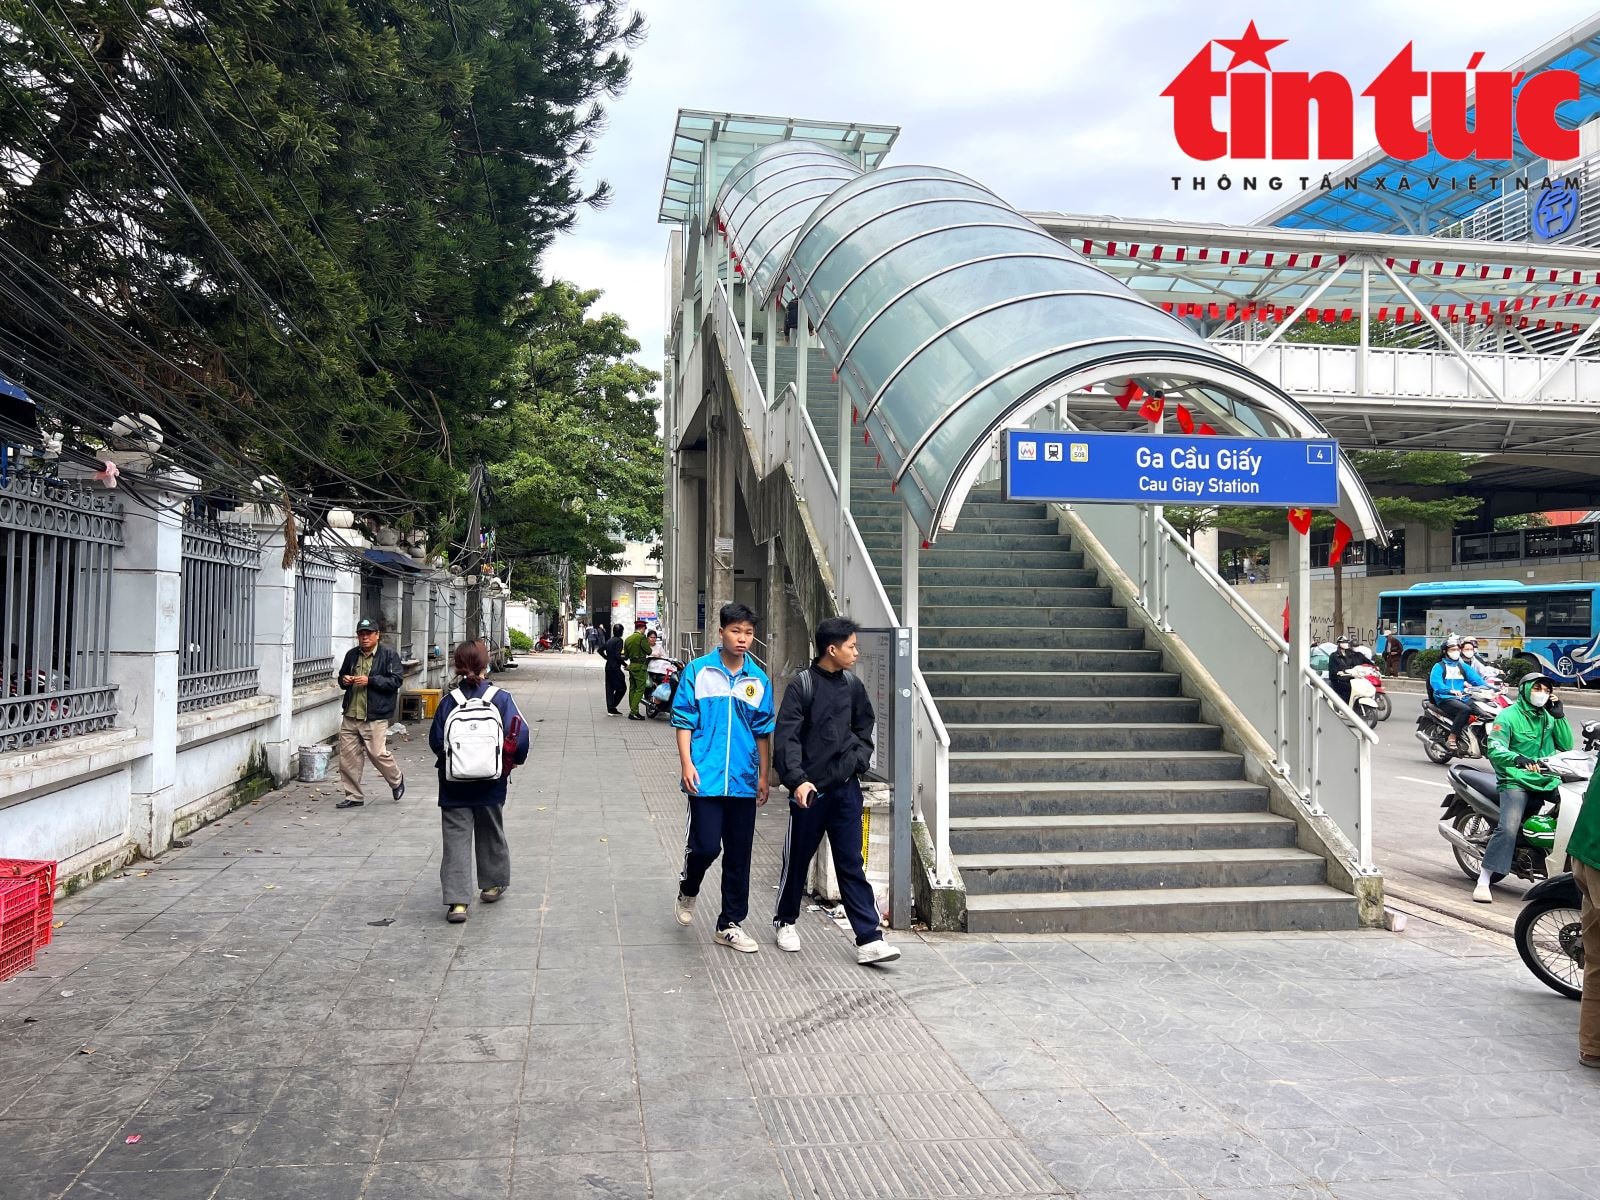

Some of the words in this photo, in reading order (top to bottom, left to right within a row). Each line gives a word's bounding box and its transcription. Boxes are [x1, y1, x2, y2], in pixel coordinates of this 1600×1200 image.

[1136, 446, 1164, 469] Ga
[1170, 446, 1210, 470] Cầu
[1216, 447, 1262, 476] Giấy
[1316, 449, 1323, 460] 4
[1139, 475, 1168, 492] Cau
[1172, 476, 1205, 496] Giay
[1208, 477, 1260, 494] Station
